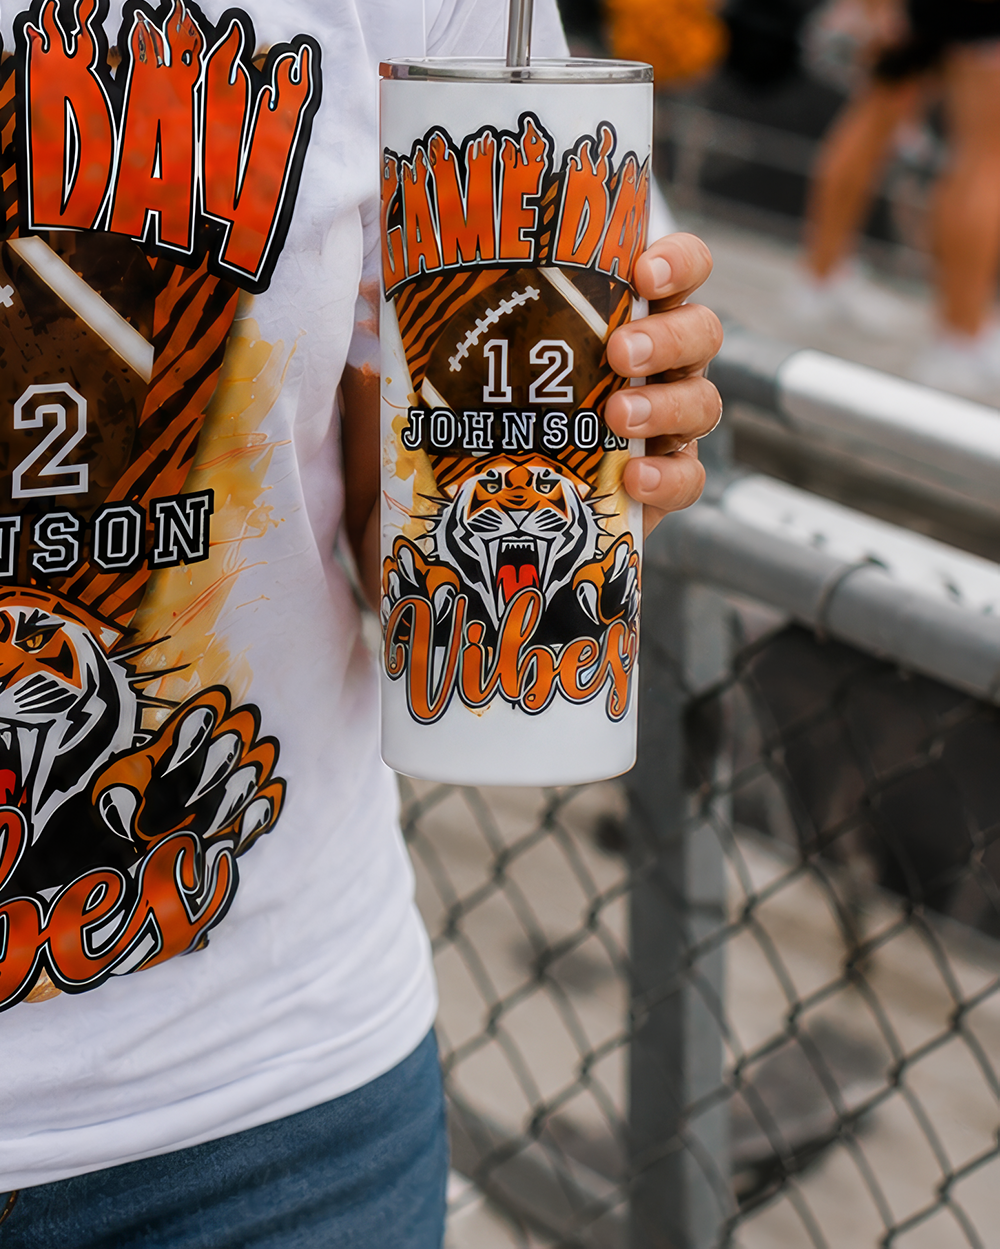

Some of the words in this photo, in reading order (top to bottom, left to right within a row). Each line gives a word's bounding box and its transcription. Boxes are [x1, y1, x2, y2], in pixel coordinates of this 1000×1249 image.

[380, 116, 547, 297] GAME
[552, 125, 651, 286] DA
[482, 338, 575, 404] 12
[382, 586, 638, 723] Vibes
